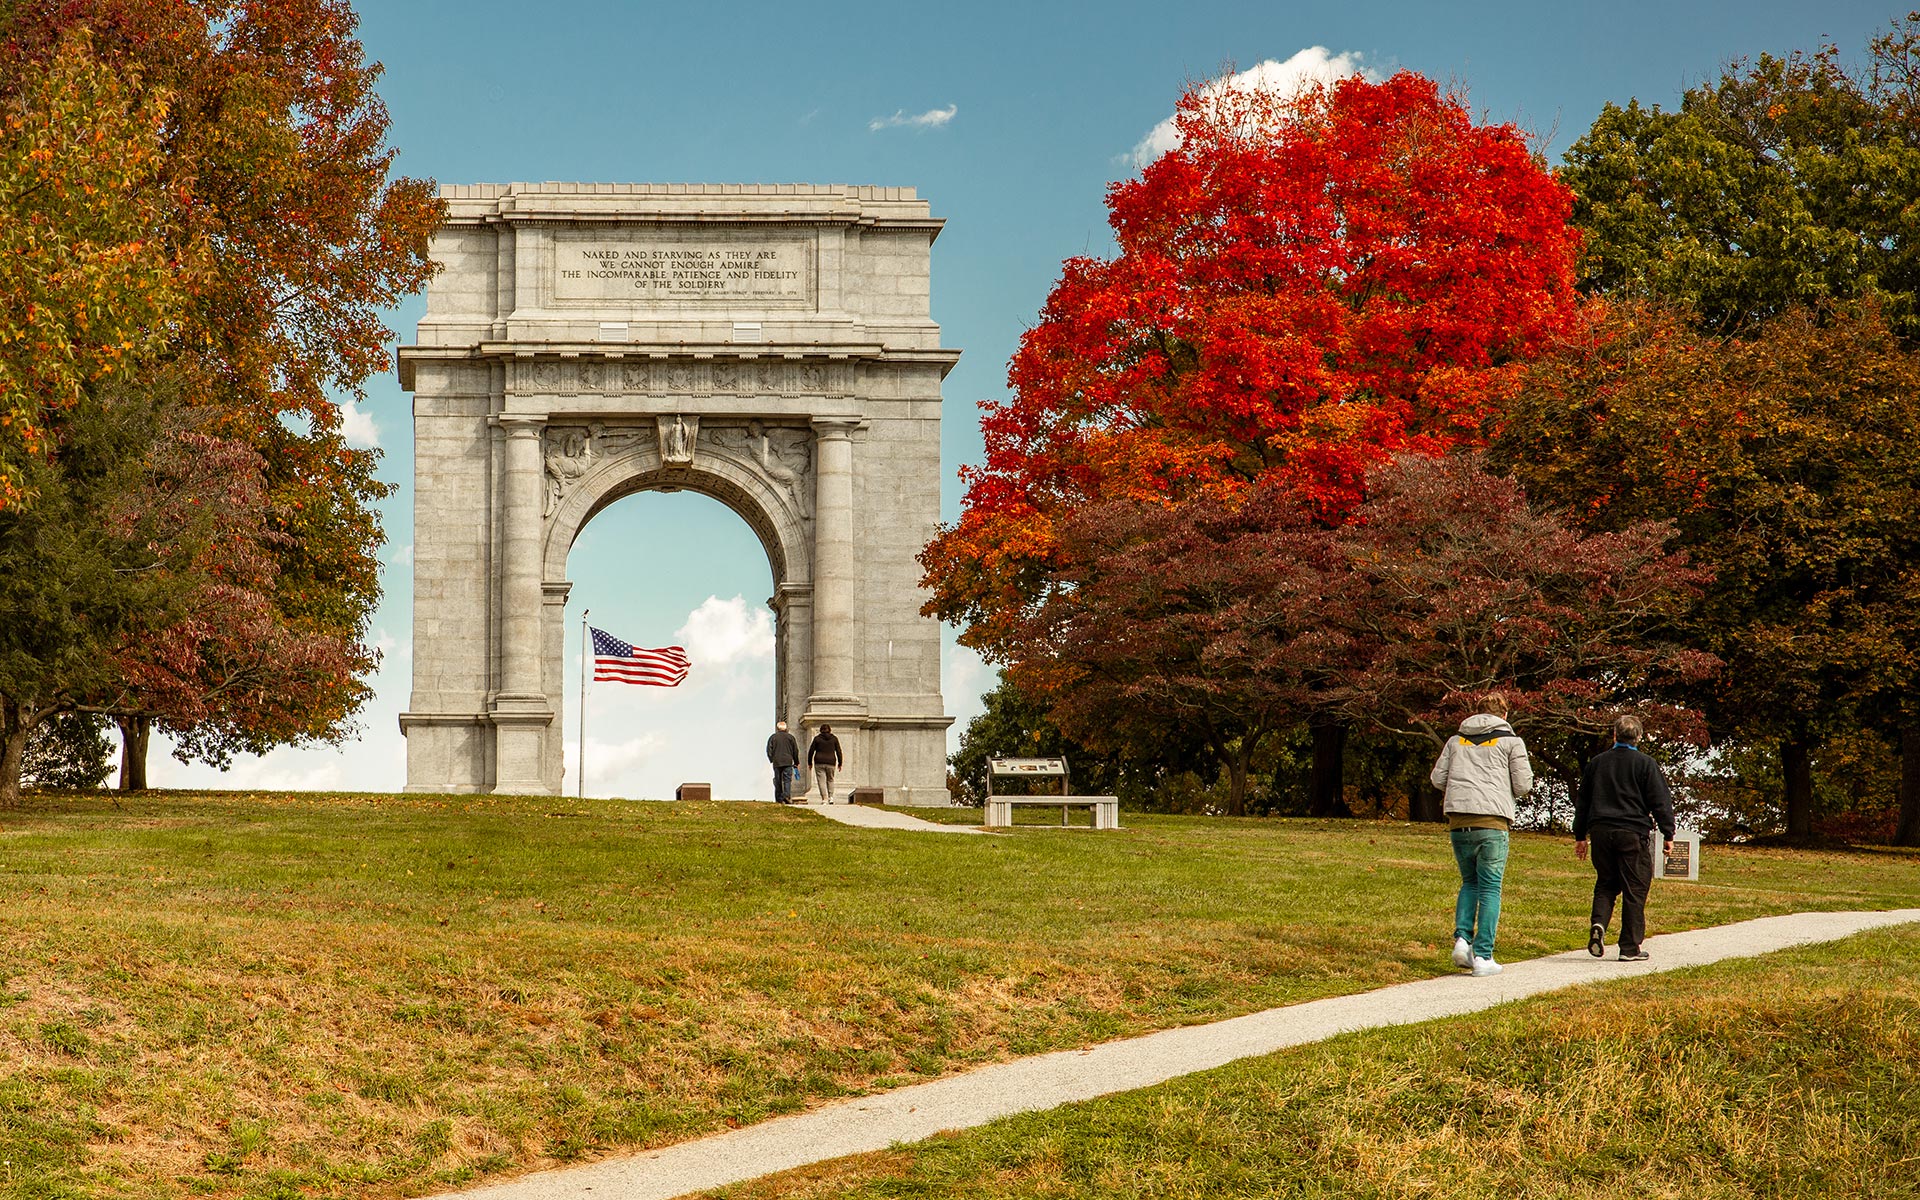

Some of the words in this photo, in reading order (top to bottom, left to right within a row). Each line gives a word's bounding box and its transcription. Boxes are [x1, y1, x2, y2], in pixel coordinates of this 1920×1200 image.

[583, 251, 619, 260] NAKED
[624, 251, 647, 260] AND
[653, 251, 702, 260] STARVING
[708, 251, 720, 260] AS
[725, 251, 751, 260] THEY
[757, 251, 776, 260] ARE
[600, 261, 616, 270] WE
[621, 261, 665, 270] CANNOT
[671, 261, 714, 270] ENOUGH
[719, 261, 759, 270] ADMIRE
[561, 270, 581, 279] THE
[587, 270, 667, 279] INCOMPARABLE
[673, 270, 721, 279] PATIENCE
[727, 270, 749, 279] AND
[755, 270, 797, 279] FIDELITY
[635, 280, 648, 289] OF
[653, 280, 672, 289] THE
[678, 280, 725, 289] SOLDIERY
